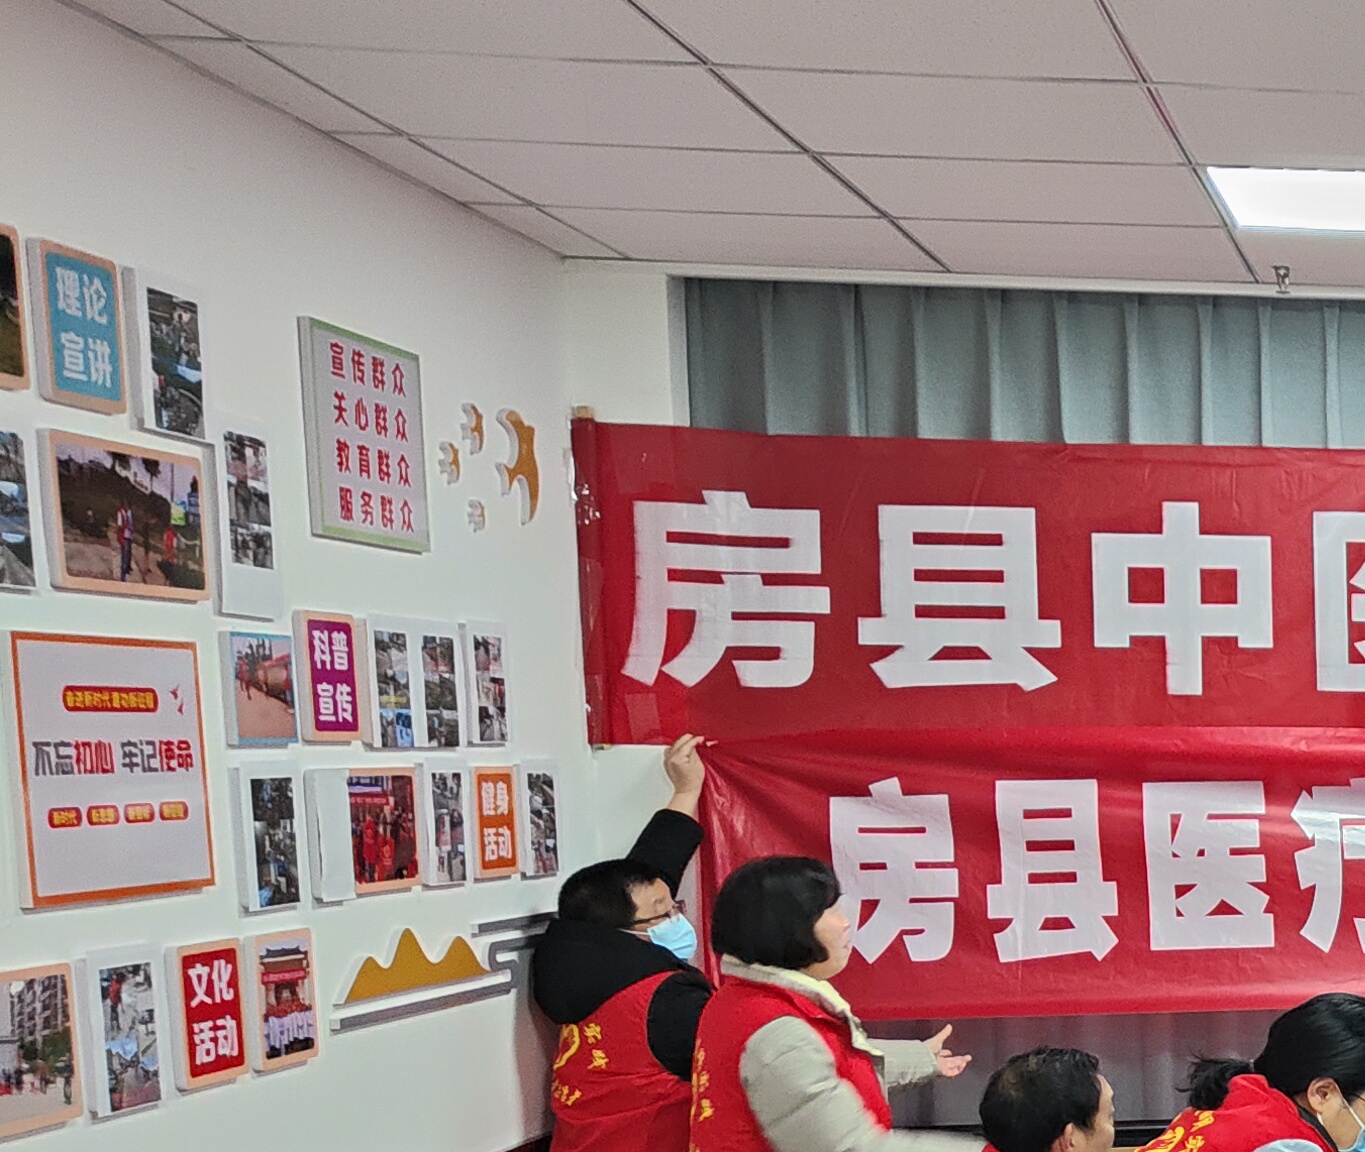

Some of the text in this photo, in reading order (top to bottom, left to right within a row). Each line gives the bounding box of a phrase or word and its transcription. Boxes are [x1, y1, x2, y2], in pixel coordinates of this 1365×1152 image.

[54, 266, 109, 325] 理论
[60, 330, 114, 389] 宣讲
[329, 340, 408, 398] 宣传群众
[333, 391, 410, 444] 关心群众
[336, 438, 413, 488] 教育群众
[338, 486, 415, 535] 服务群众
[311, 629, 349, 673] 科普
[315, 680, 355, 725] 宣传
[31, 738, 194, 777] 不忘初心 牢记使命
[479, 780, 513, 818] 健身
[482, 826, 514, 864] 活动
[186, 957, 235, 1008] 文化
[192, 1016, 241, 1066] 活动
